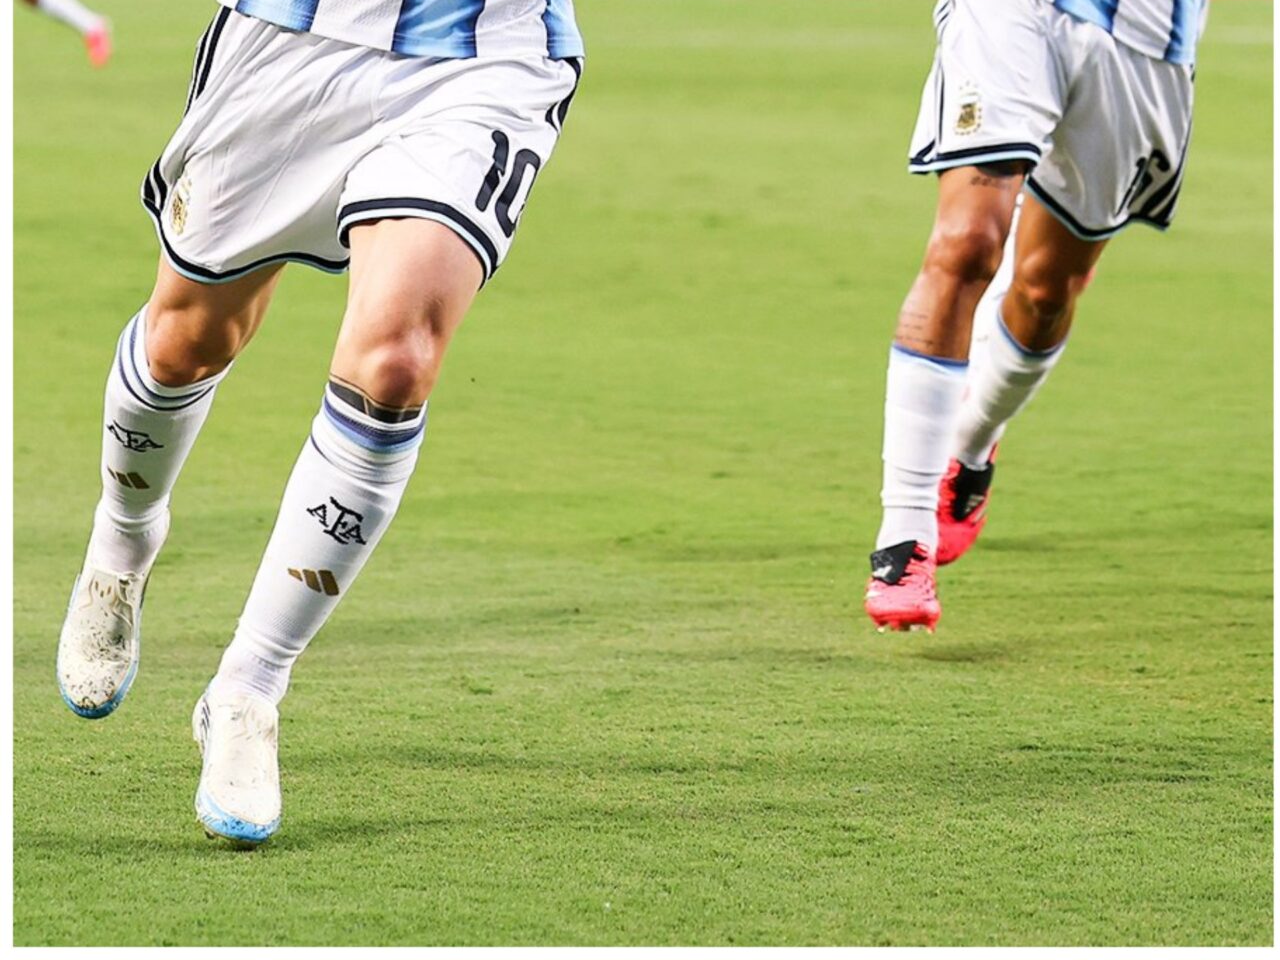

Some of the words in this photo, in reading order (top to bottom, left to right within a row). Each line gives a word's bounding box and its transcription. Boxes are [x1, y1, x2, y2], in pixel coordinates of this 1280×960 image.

[475, 129, 541, 239] 10
[107, 419, 165, 453] AFA
[306, 496, 367, 545] AFA
